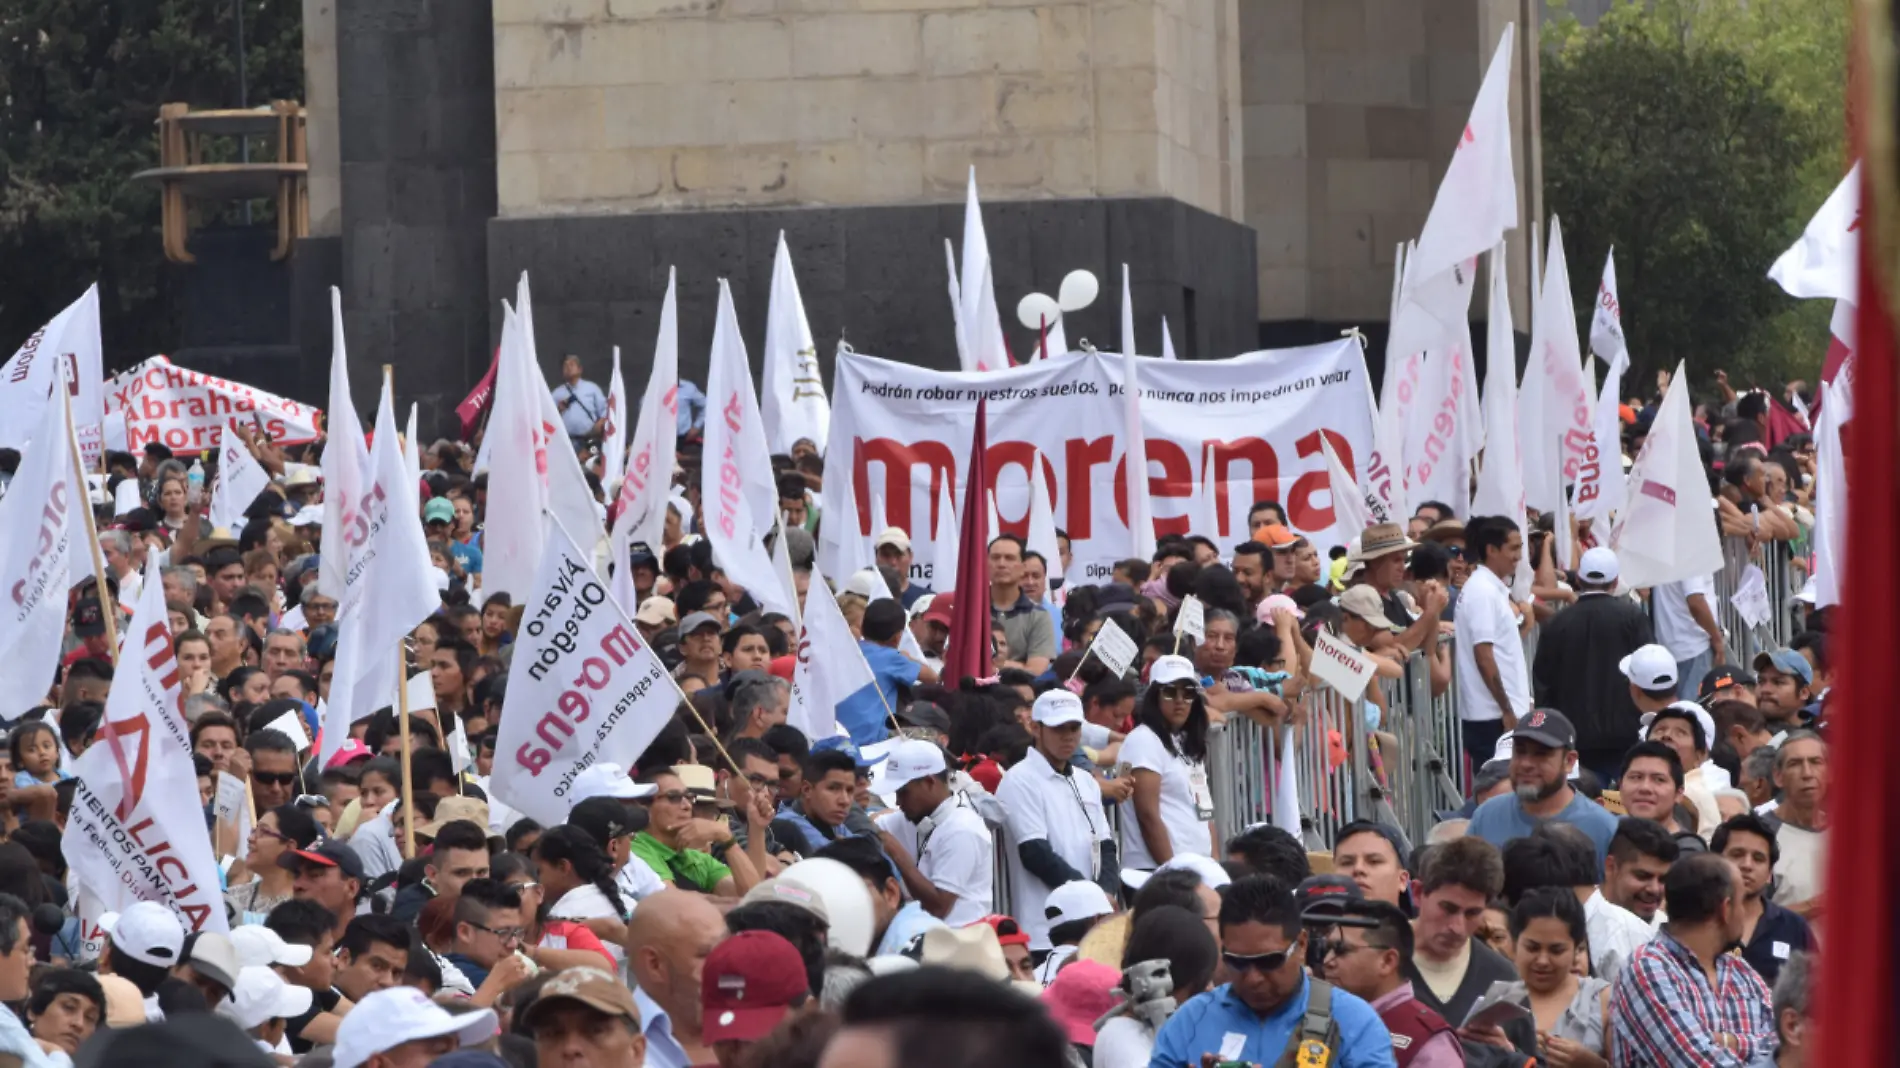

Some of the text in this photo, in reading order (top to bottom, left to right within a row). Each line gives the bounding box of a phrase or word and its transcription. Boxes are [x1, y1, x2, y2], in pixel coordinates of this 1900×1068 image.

[125, 389, 256, 422] Abraha
[861, 380, 912, 399] Podrán
[916, 385, 960, 400] robar
[967, 387, 1038, 401] nuestros
[1147, 387, 1195, 403] nunca
[1199, 391, 1227, 404] nos
[129, 416, 288, 450] Morals
[852, 427, 1357, 541] morena
[1318, 635, 1364, 676] morena
[77, 778, 136, 854] RIENTOS
